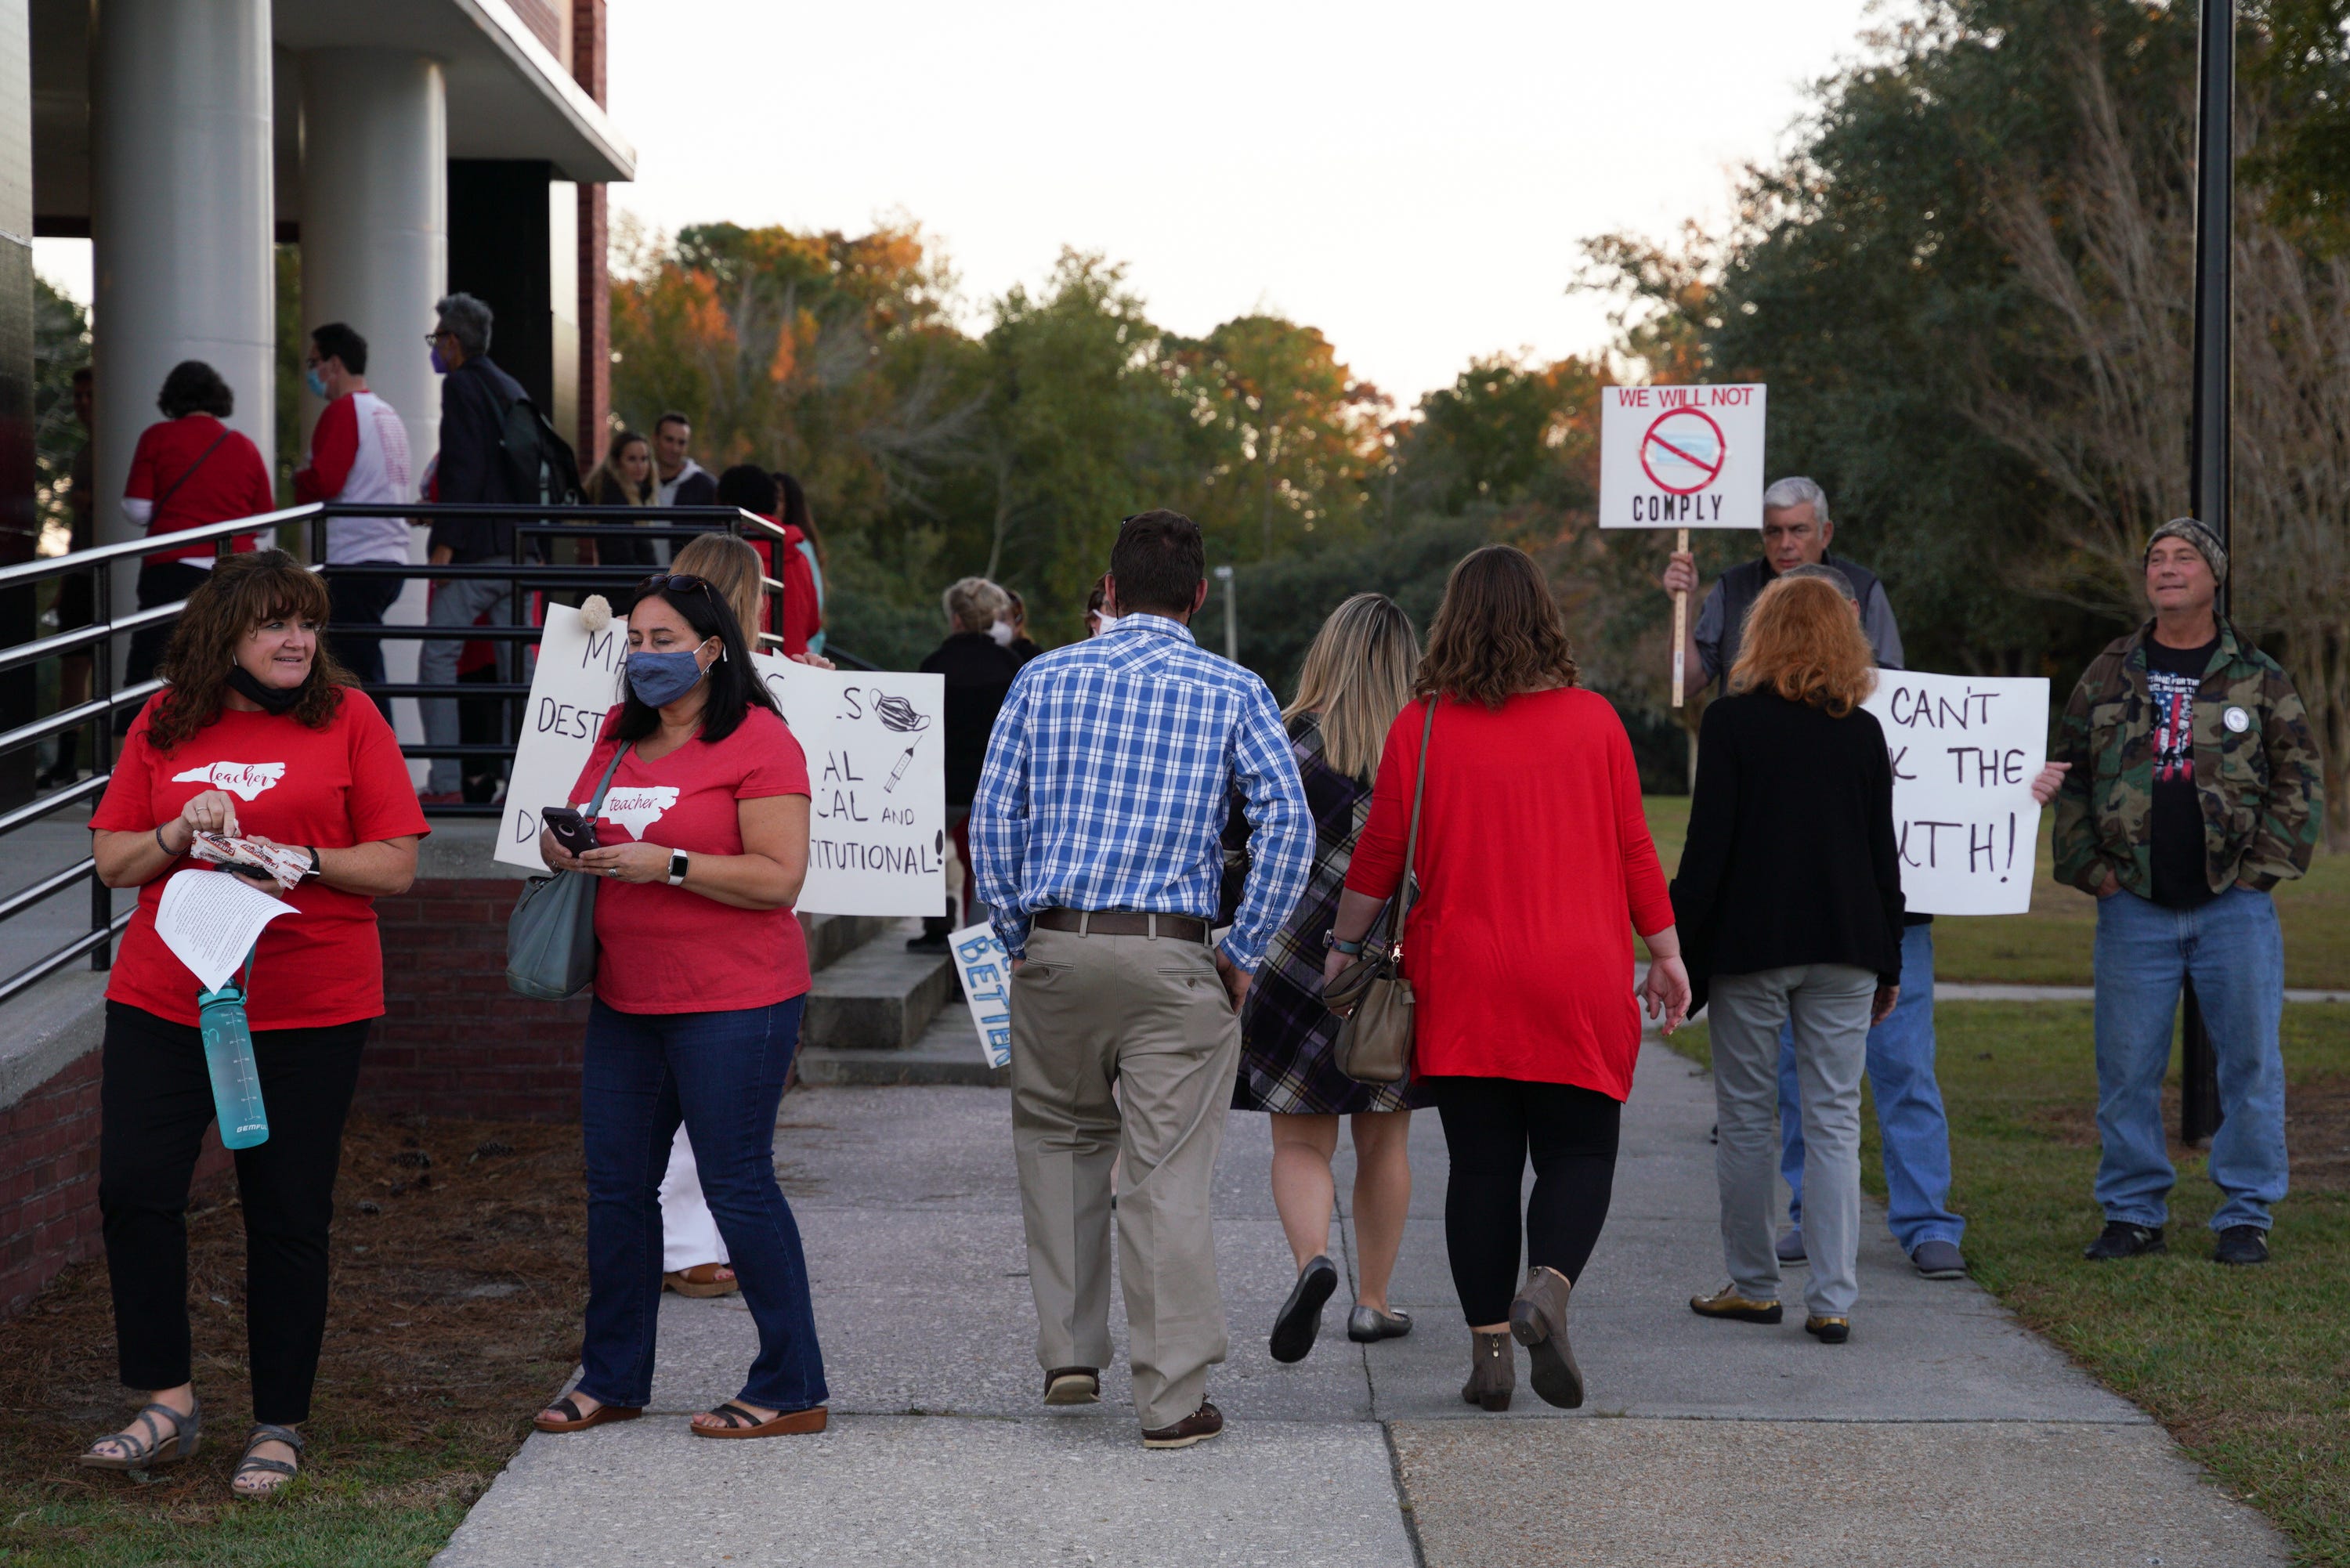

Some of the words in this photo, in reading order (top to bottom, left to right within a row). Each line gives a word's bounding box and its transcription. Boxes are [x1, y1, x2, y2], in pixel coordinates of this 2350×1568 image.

[1619, 388, 1649, 407] WE
[1658, 388, 1706, 407] WILL
[1712, 388, 1754, 406] NOT
[1633, 494, 1723, 522] COMPLY
[1891, 686, 2000, 729] CAN'T
[1947, 747, 2026, 788] THE
[609, 793, 658, 811] teacher
[882, 807, 914, 826] AND
